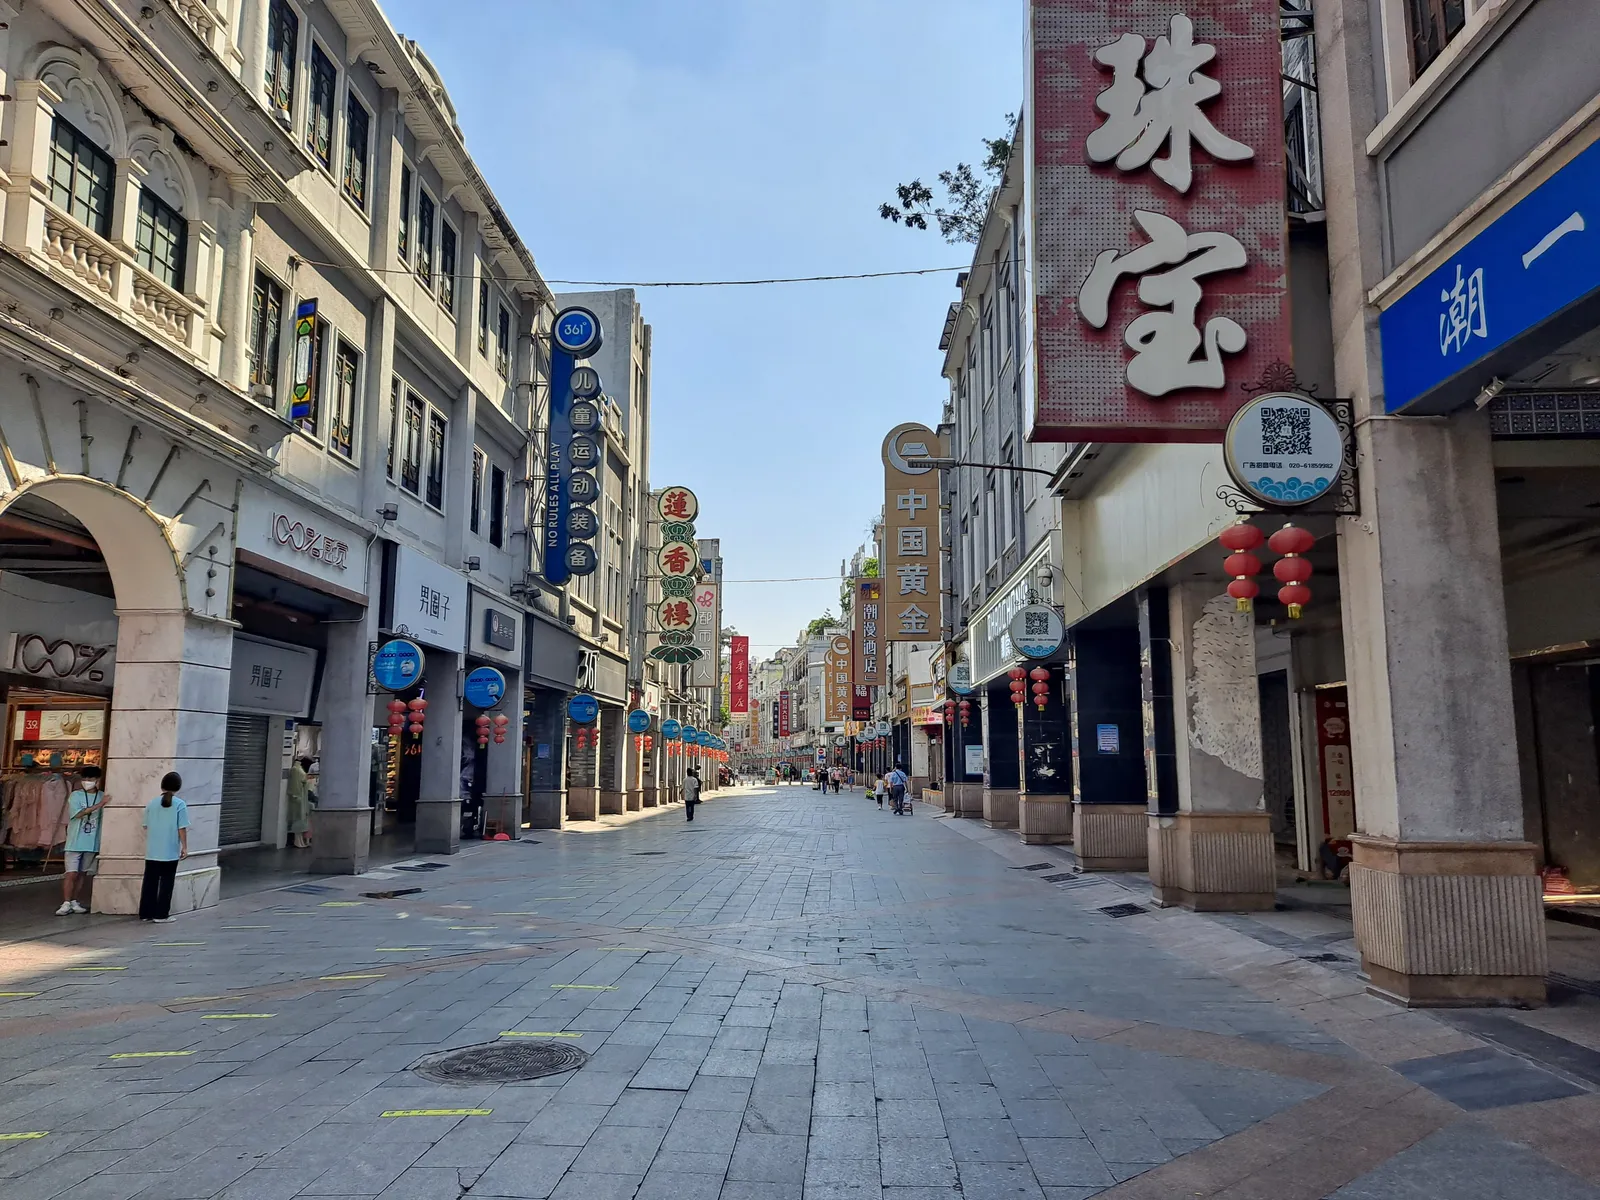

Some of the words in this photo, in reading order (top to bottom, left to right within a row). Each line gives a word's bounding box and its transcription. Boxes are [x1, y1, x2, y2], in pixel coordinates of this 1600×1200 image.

[1078, 13, 1255, 397] 珠宝
[550, 442, 561, 470] PLAY
[550, 473, 560, 492] ALL
[569, 372, 593, 567] 儿童运动装备
[548, 530, 558, 547] NO
[549, 494, 559, 528] RULES
[662, 491, 692, 627] 蓮香樓
[897, 488, 929, 634] 中国黄金
[419, 584, 451, 622] 男圈子
[5, 632, 108, 682] 100%
[698, 611, 713, 679] 都市丽人
[863, 603, 878, 674] 潮漫酒店
[836, 658, 848, 713] 中国黄金
